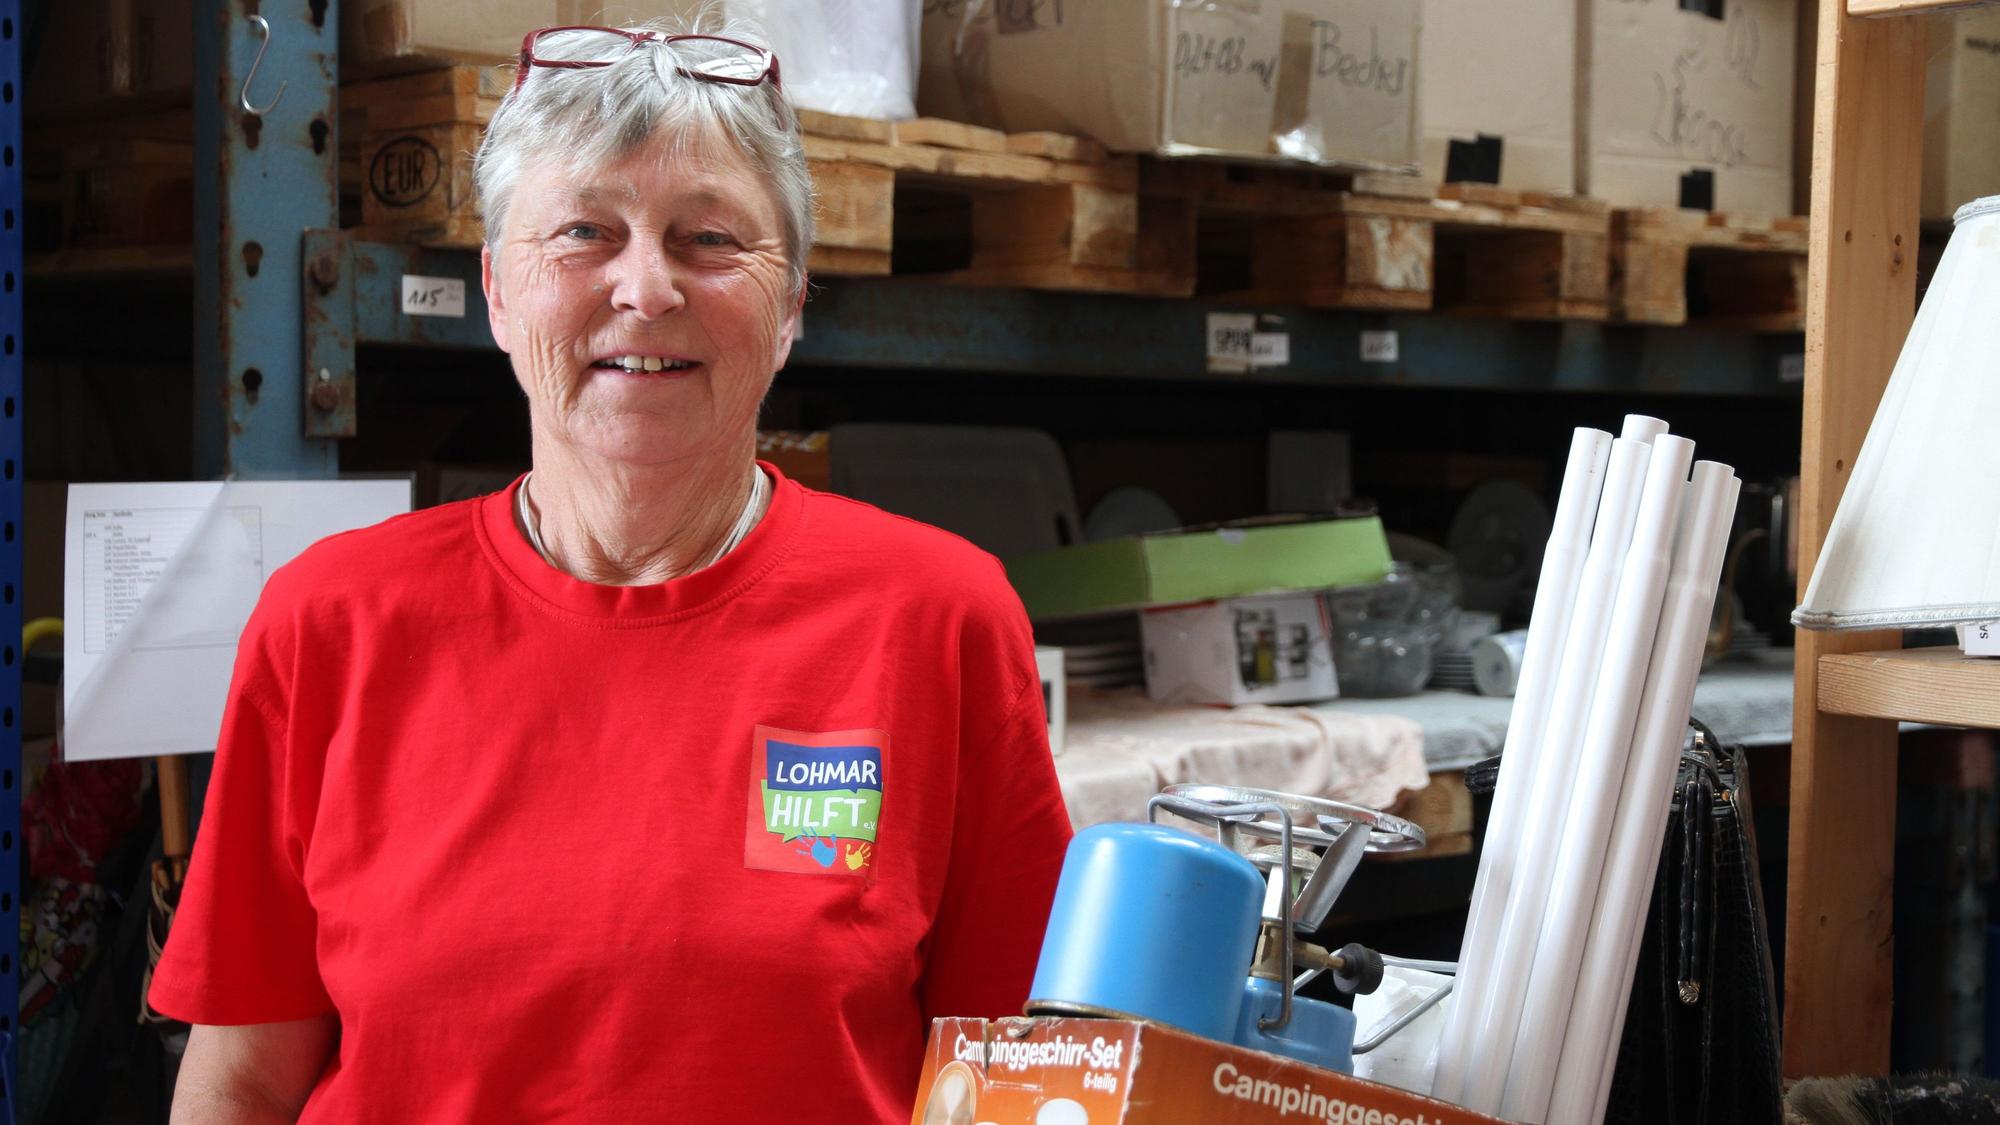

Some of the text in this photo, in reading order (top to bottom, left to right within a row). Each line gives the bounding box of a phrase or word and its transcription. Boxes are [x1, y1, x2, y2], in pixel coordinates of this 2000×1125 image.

[384, 149, 425, 195] EUR
[407, 286, 445, 307] 115
[776, 759, 877, 786] LOHMAR
[770, 793, 867, 828] HILFT
[954, 1032, 1123, 1072] Campinggeschirr-Set
[1083, 1071, 1118, 1094] 6-teilig
[1212, 1061, 1442, 1125] Campingges
